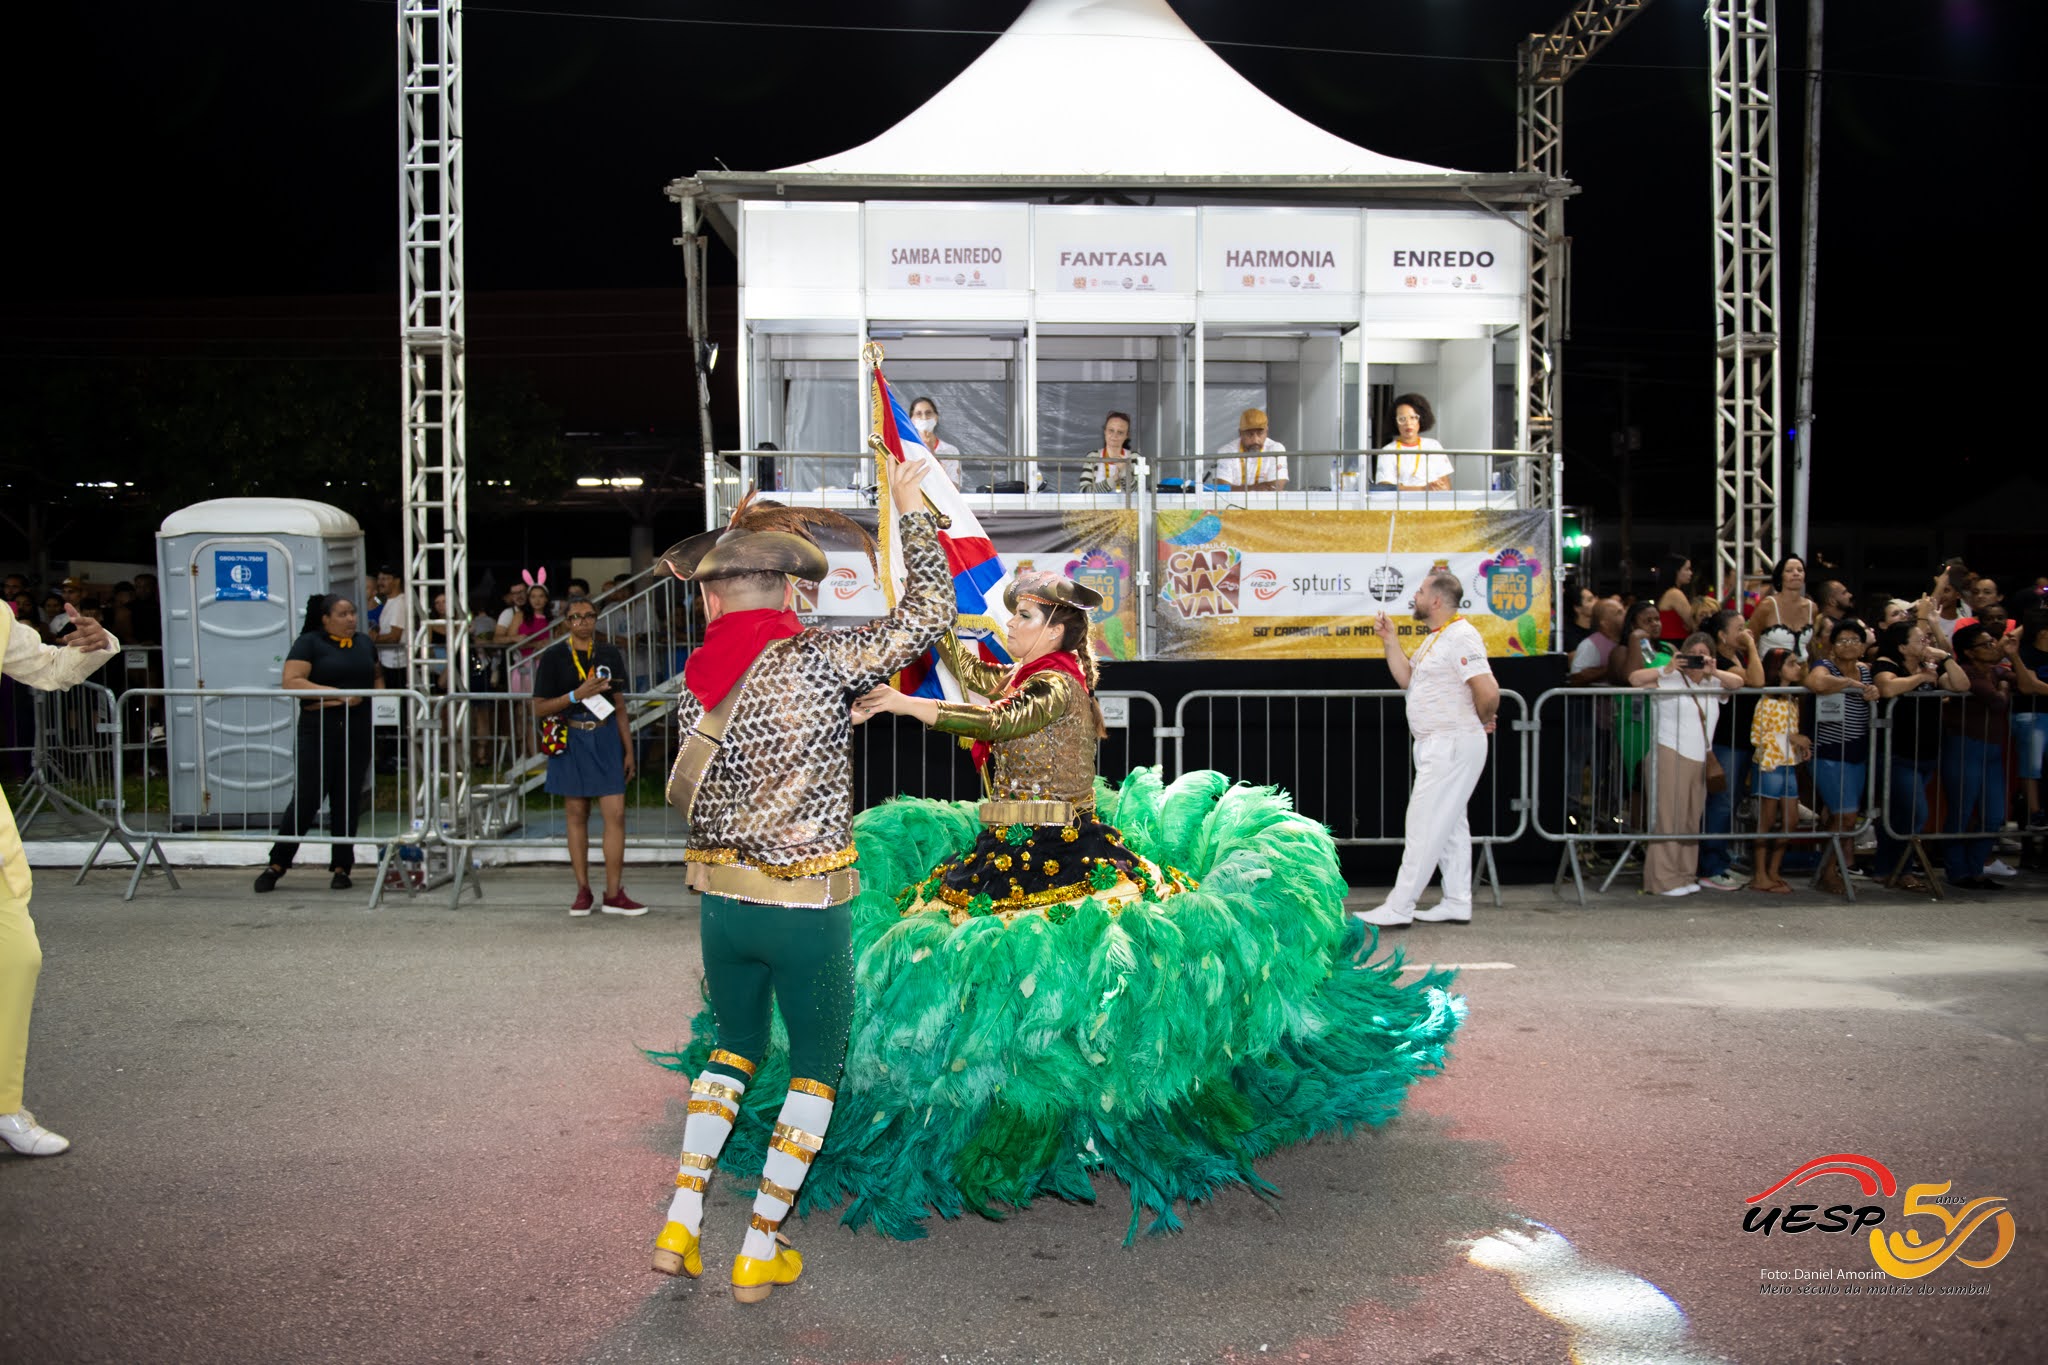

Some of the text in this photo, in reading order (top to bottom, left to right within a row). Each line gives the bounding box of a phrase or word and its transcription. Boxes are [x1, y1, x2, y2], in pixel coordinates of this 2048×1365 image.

[891, 247, 1002, 265] SAMBA ENREDO
[1060, 251, 1168, 267] FANTASIA
[1226, 250, 1336, 268] HARMONIA
[1393, 250, 1495, 268] ENREDO
[1199, 542, 1227, 550] PAULO
[1292, 574, 1352, 595] spturis
[1492, 583, 1527, 593] PAULO
[1492, 593, 1527, 610] 470
[1217, 616, 1240, 625] 2024
[1274, 626, 1333, 636] CARNAVAL
[1336, 626, 1351, 636] DA
[1354, 626, 1375, 636] MAT
[1398, 625, 1412, 636] DO
